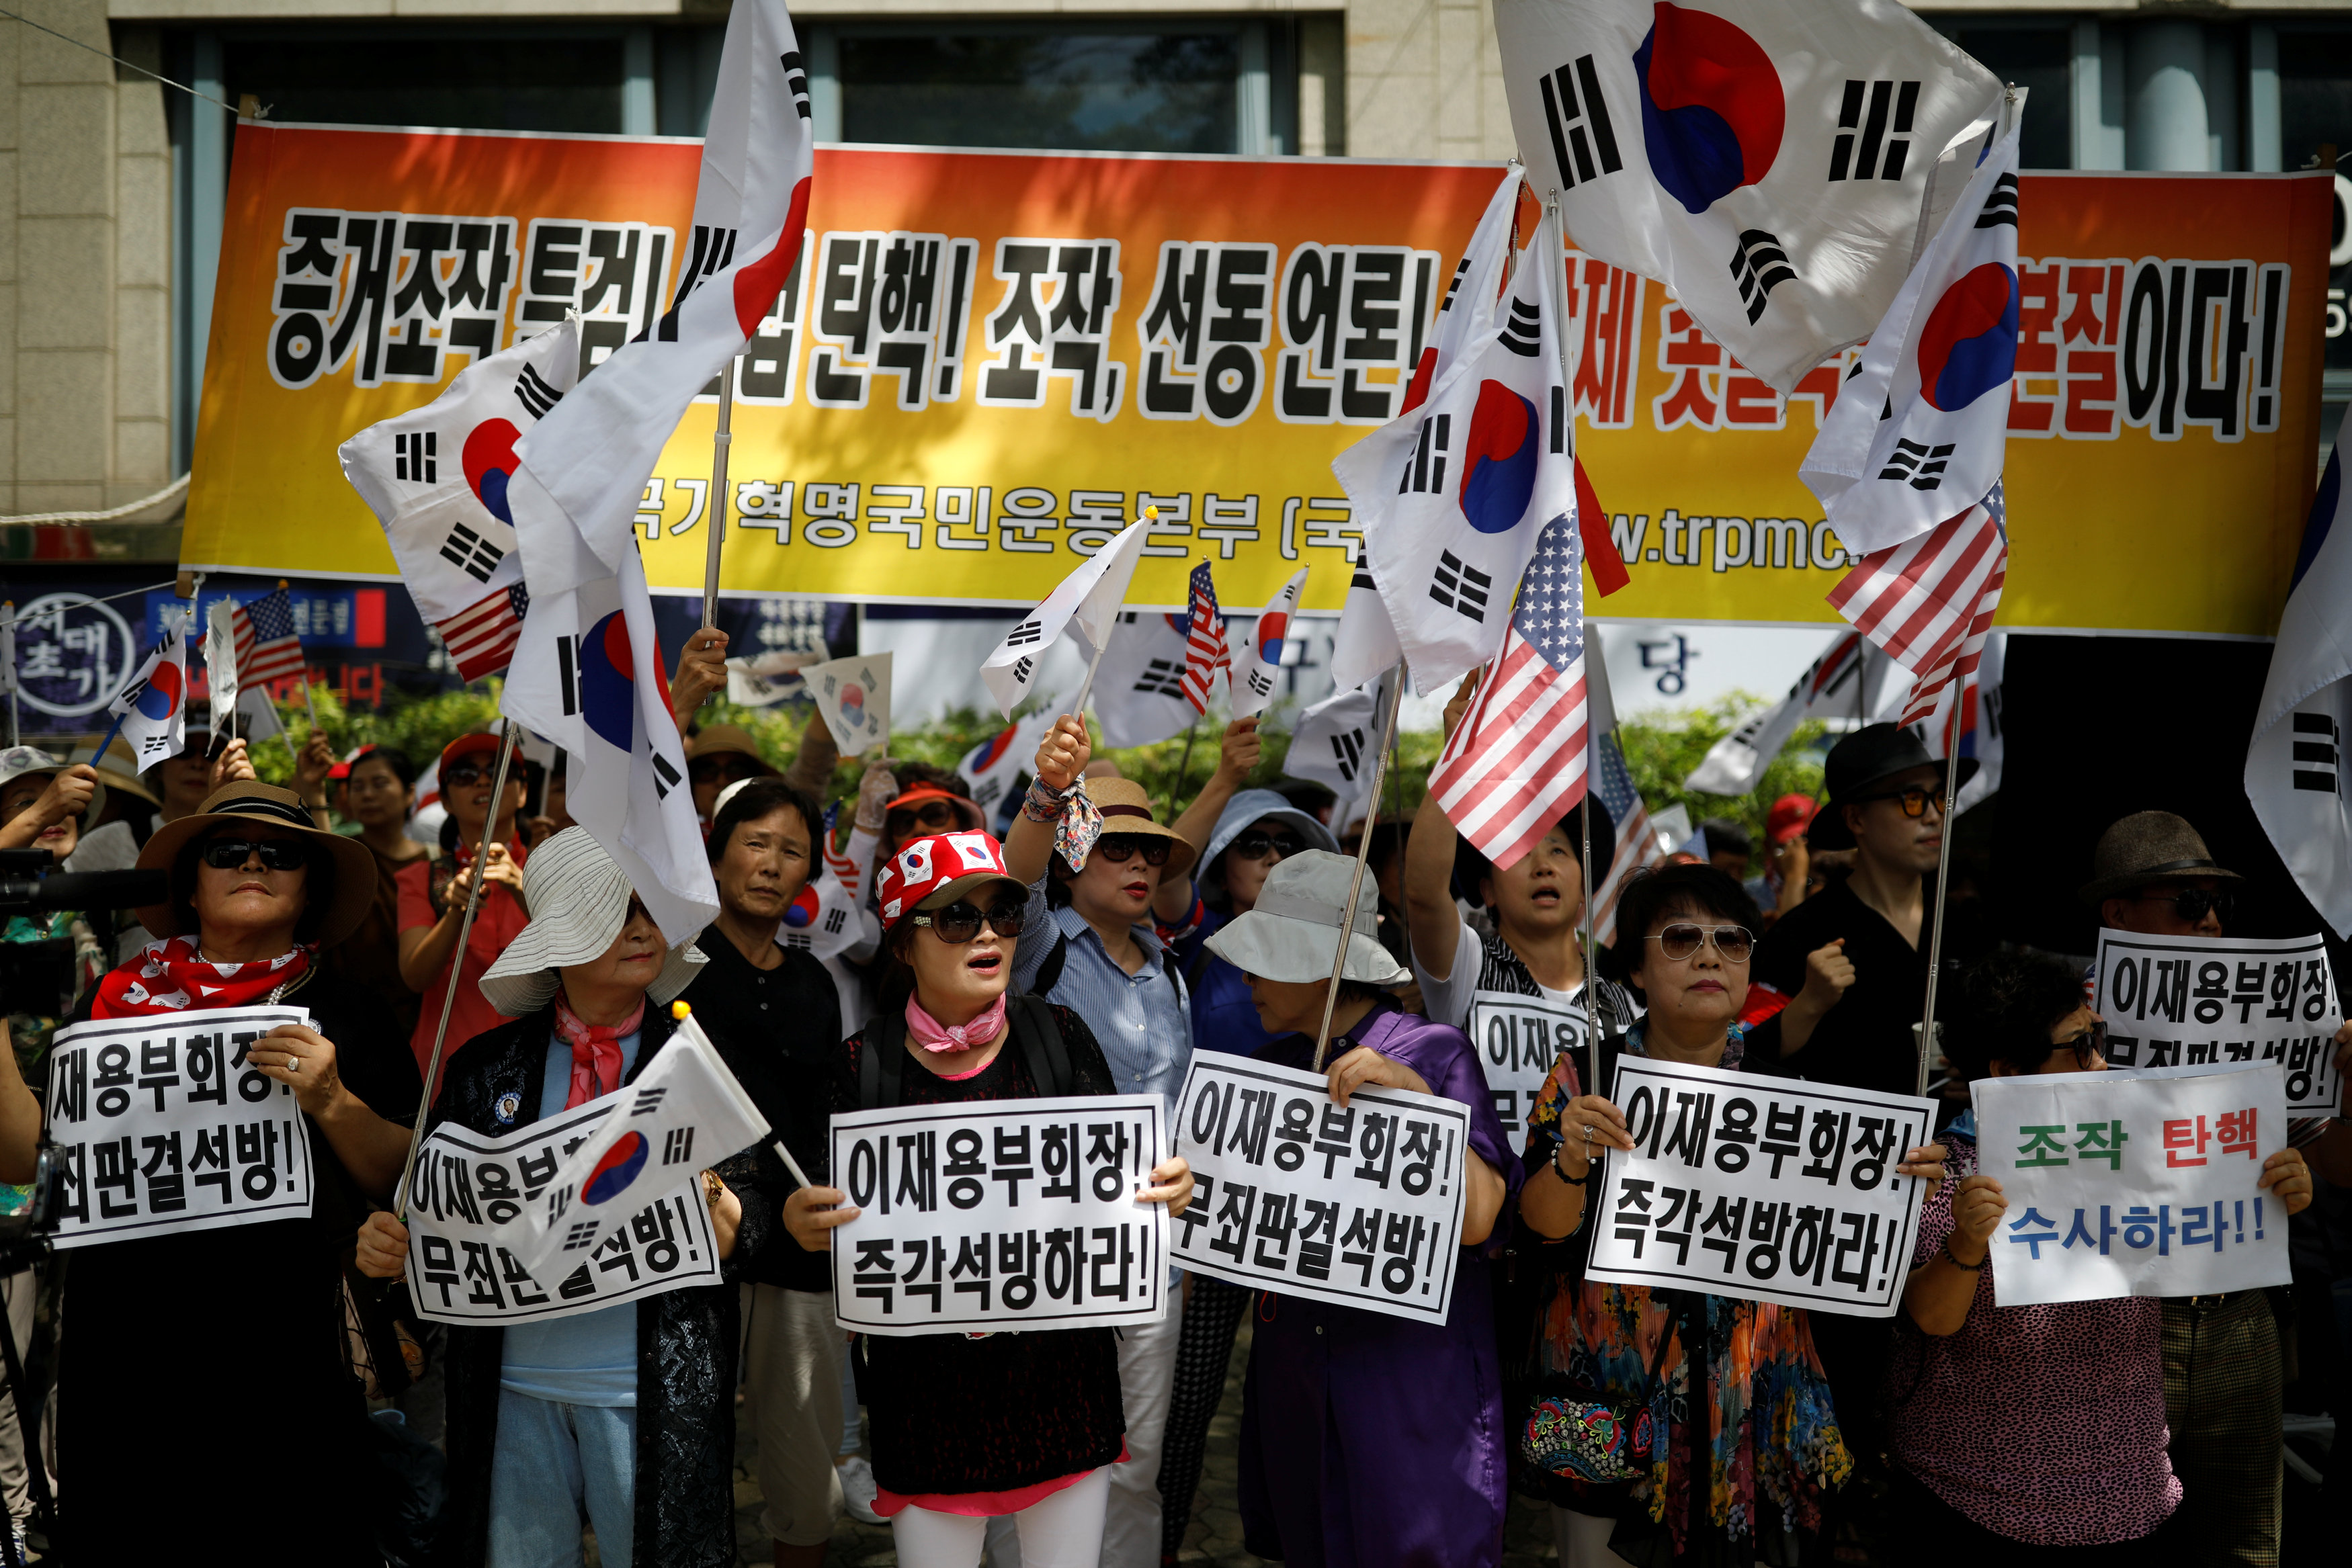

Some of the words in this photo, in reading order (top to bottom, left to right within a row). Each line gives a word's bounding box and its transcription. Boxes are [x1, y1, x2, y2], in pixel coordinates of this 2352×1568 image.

[275, 214, 511, 382] 증거조작
[814, 236, 970, 404] 탄핵!
[985, 245, 1118, 415] 조작,
[1146, 247, 1269, 419] 선동
[1284, 249, 1432, 419] 언론!
[2007, 263, 2283, 435] 본질이다!
[2112, 956, 2337, 1025] 이재용부회장!
[46, 1031, 291, 1129] 재용부회장
[60, 1119, 295, 1224] 죄판결석방!
[848, 1121, 1142, 1215] 이재용부회장!
[1191, 1079, 1455, 1197] 이재용부회장!
[1626, 1084, 1913, 1192] 이재용부회장!
[2015, 1119, 2128, 1171] 조작
[2162, 1107, 2258, 1168] 탄핵
[852, 1223, 1148, 1315] 즉각석방하라!
[1174, 1171, 1441, 1297] 무죄판결석방!
[1613, 1177, 1898, 1293] 즉각석방하라!
[2008, 1196, 2265, 1260] 수사하라!!
